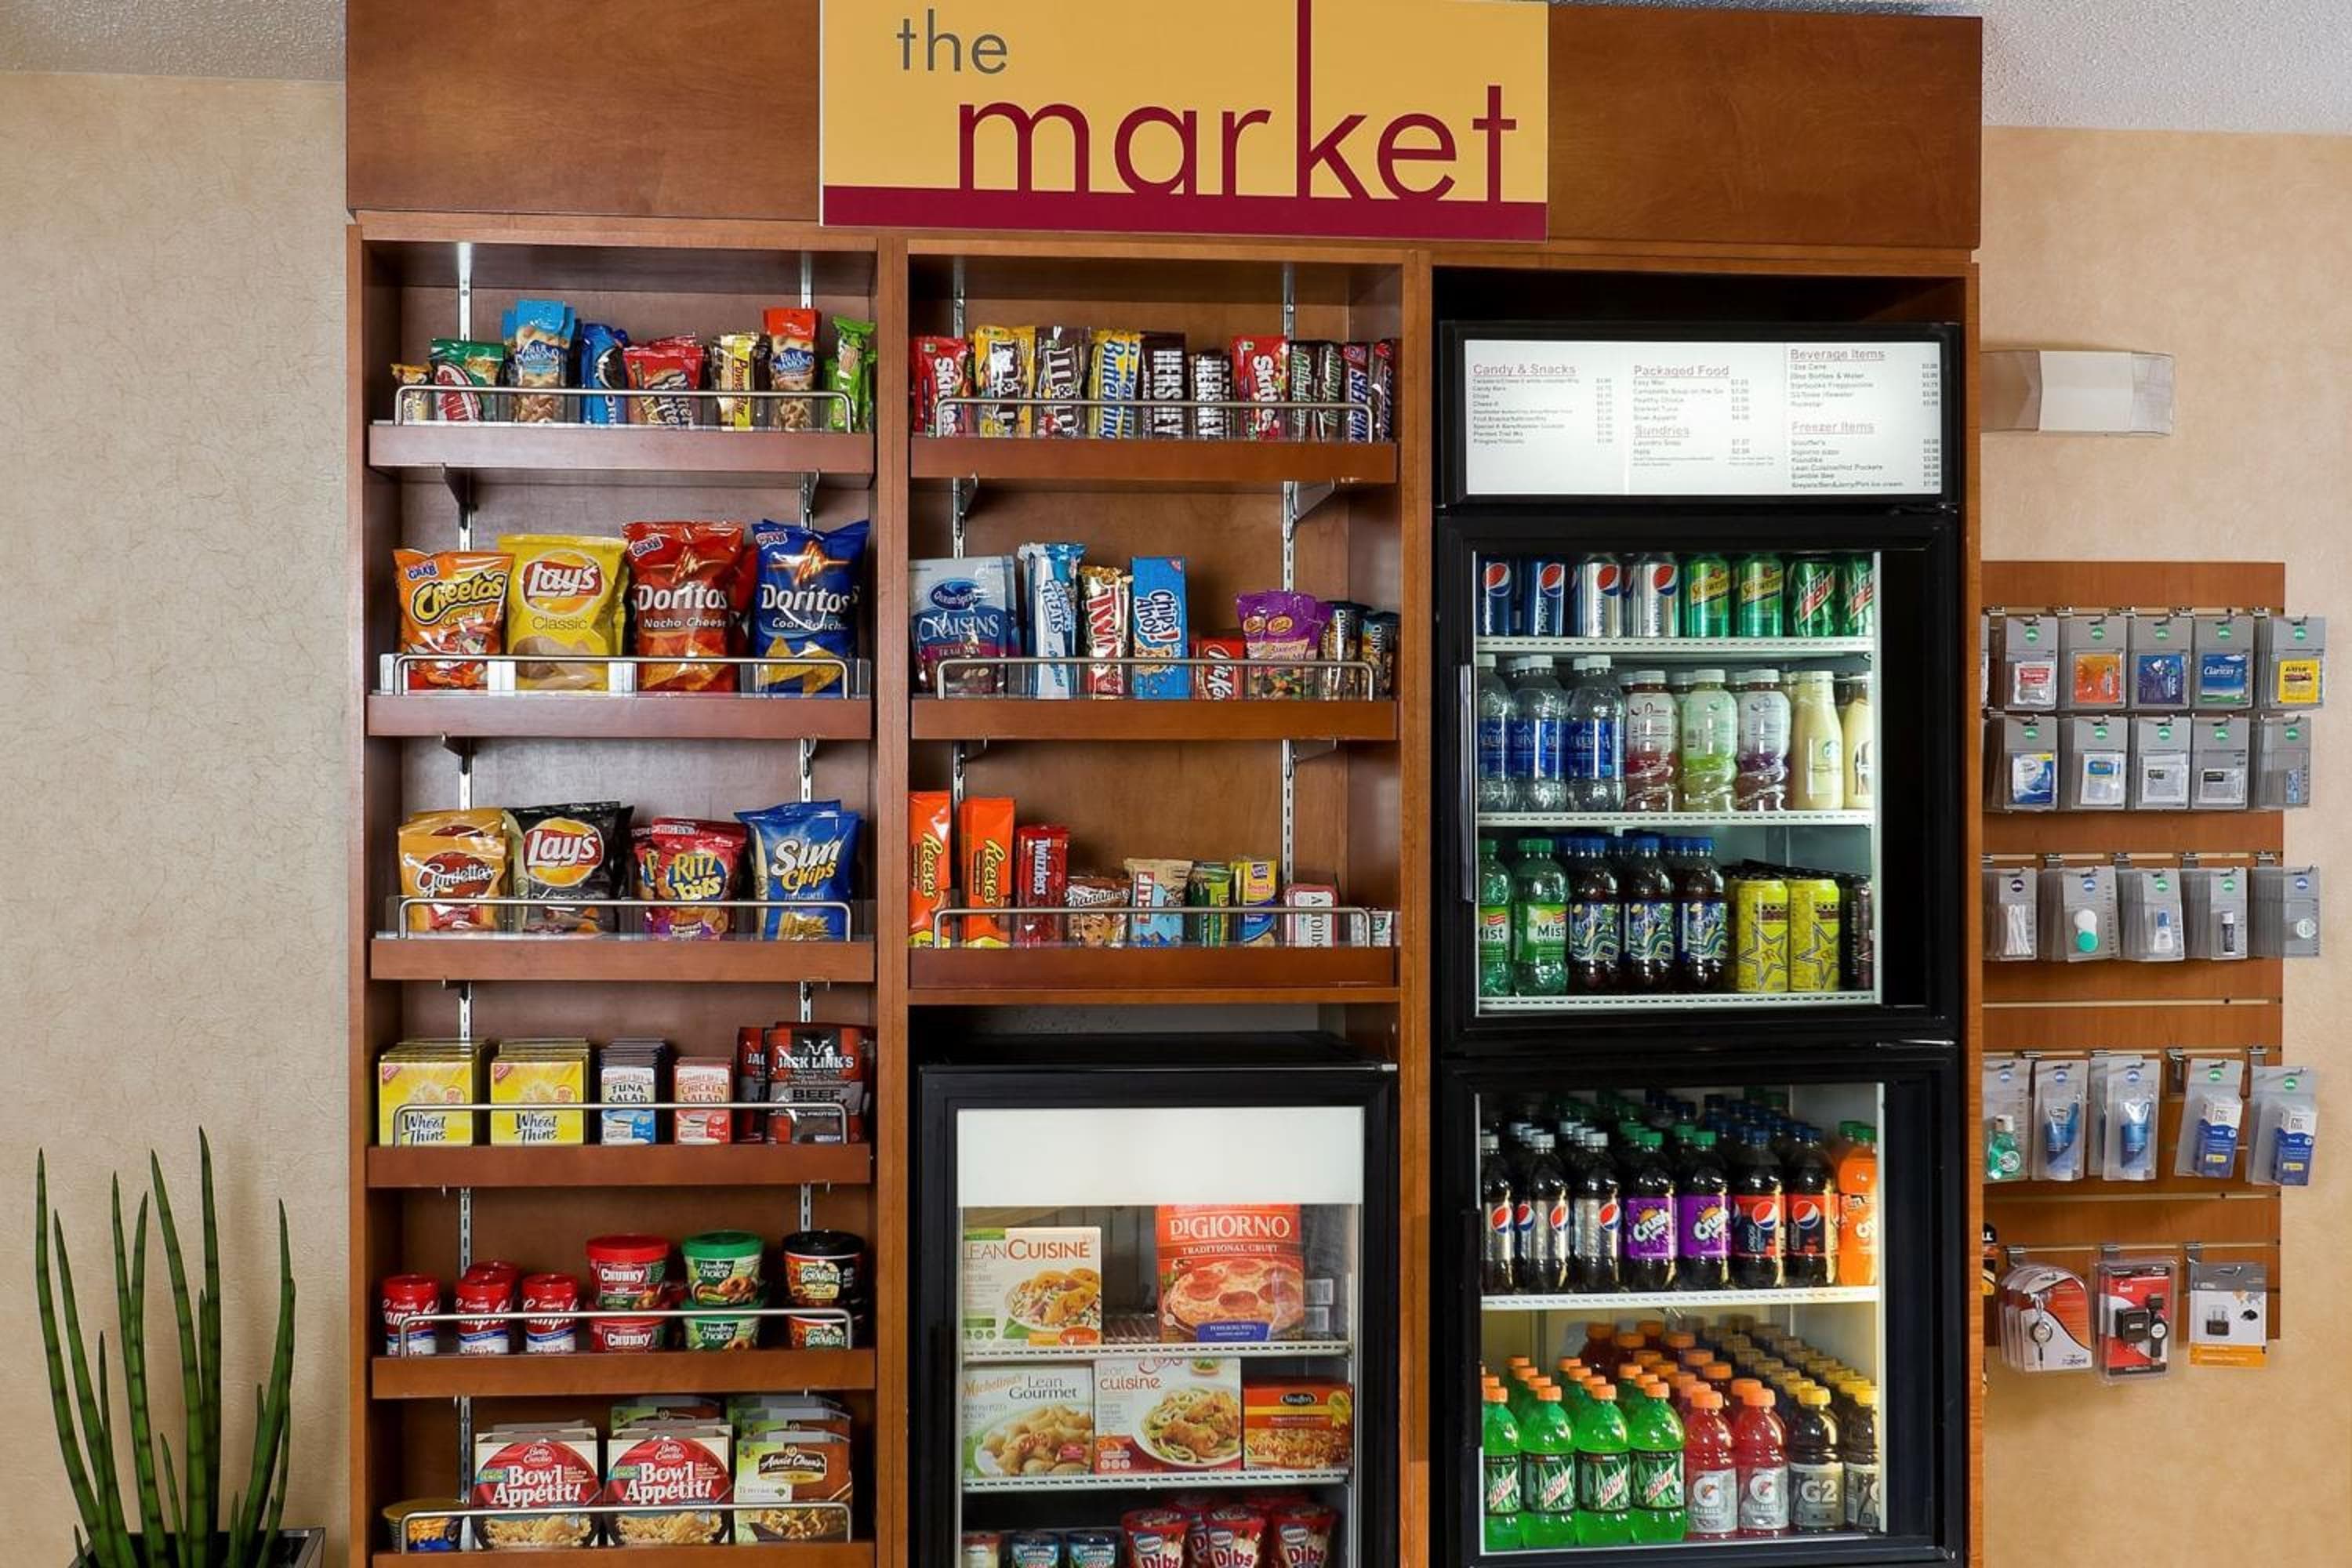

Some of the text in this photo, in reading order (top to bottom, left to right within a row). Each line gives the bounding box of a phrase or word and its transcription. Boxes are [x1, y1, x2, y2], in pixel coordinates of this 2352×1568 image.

[897, 9, 1007, 73] the
[959, 0, 1517, 202] market
[1791, 350, 1885, 361] Beverage Items
[1473, 363, 1576, 376] Candy & Snacks
[1634, 365, 1730, 377] Packaged Food
[1154, 350, 1184, 437] HERSEY
[1635, 424, 1690, 437] Sundries
[1792, 422, 1875, 434] Freezer Items
[528, 562, 600, 599] Lay's
[414, 572, 505, 622] Cheetos
[638, 583, 728, 612] Doritos
[761, 583, 851, 615] Doritos
[1041, 581, 1063, 633] TREATS
[1151, 590, 1178, 632] Chips
[532, 617, 588, 630] Classic
[644, 618, 681, 628] Nacho
[528, 831, 598, 868] Lay's
[771, 840, 845, 876] Sun
[673, 851, 718, 882] RITZ
[1033, 838, 1051, 896] Twizzlers
[782, 861, 837, 892] Chips
[672, 875, 721, 901] bits
[1537, 924, 1566, 938] Mist
[811, 1055, 854, 1069] LINK'S
[612, 1083, 644, 1094] TUNA
[793, 1089, 841, 1098] BEEF
[405, 1112, 446, 1130] Wheat
[516, 1112, 557, 1130] Wheat
[401, 1127, 446, 1142] Thins
[514, 1127, 557, 1142] Thins
[1008, 1238, 1091, 1261] CUISINE
[1182, 1243, 1278, 1255] TRADITIONAL CRUST
[600, 1268, 644, 1282] CHUNKY
[698, 1269, 731, 1280] Choice
[607, 1332, 652, 1346] CHUNKY
[702, 1331, 732, 1341] Choice
[1027, 1375, 1062, 1388] Lean
[1101, 1377, 1161, 1392] cuisine
[1009, 1387, 1077, 1400] Gourmet
[507, 1465, 564, 1487] Bowl
[639, 1461, 694, 1484] Bowl
[492, 1481, 581, 1508] Appétit!
[624, 1479, 712, 1505] Appétit!
[1801, 1479, 1837, 1504] G2
[1214, 1549, 1253, 1567] Dibs
[1287, 1548, 1325, 1563] Dibs
